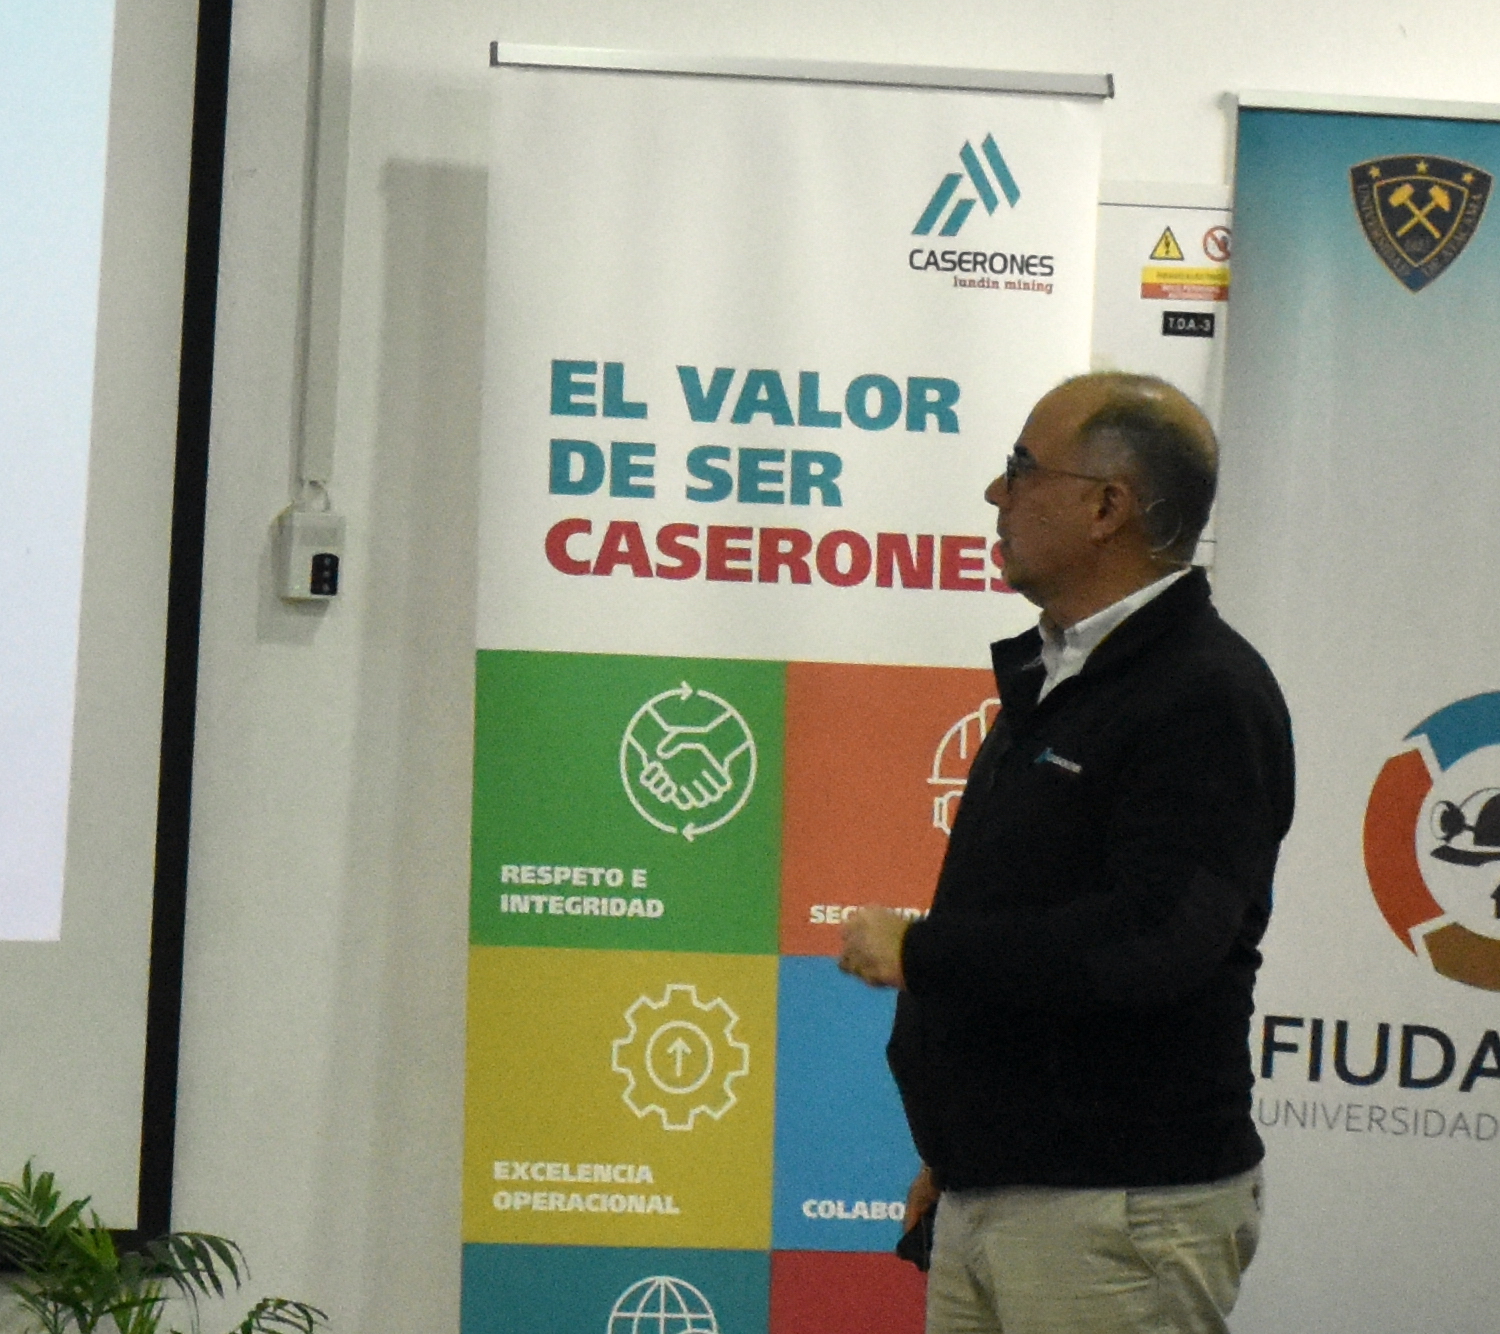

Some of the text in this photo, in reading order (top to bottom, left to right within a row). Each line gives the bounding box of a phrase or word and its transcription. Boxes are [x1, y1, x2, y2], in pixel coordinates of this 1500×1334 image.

[907, 247, 1055, 278] CASERONES
[952, 275, 1055, 295] lundin mining
[549, 359, 961, 435] EL VALOR
[549, 438, 843, 508] DE SER
[500, 863, 648, 889] RESPETO E
[500, 893, 665, 919] INTEGRIDAD
[1257, 1098, 1499, 1144] UNIVERSIDAD
[492, 1160, 654, 1185] EXCELENCIA
[492, 1189, 681, 1215] OPERACIONAL
[801, 1198, 907, 1222] COLABO
